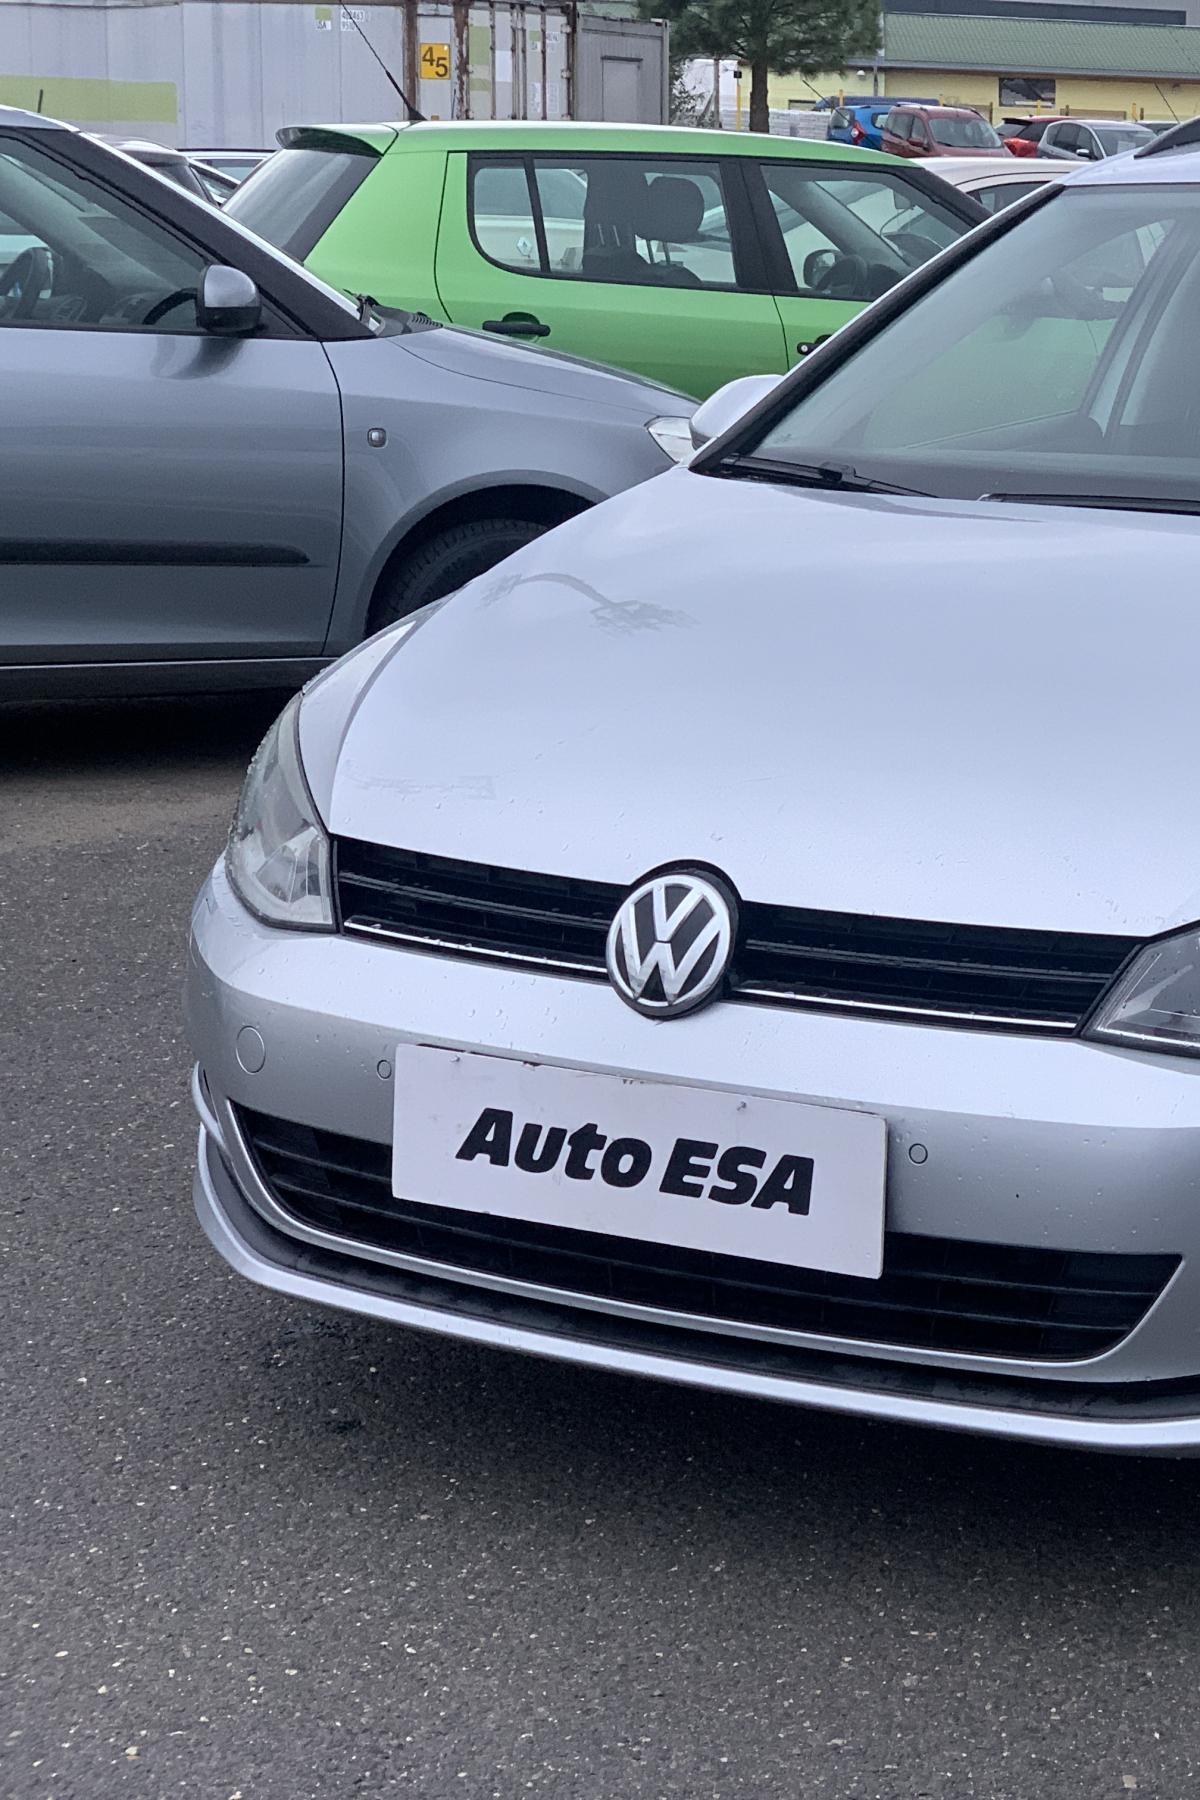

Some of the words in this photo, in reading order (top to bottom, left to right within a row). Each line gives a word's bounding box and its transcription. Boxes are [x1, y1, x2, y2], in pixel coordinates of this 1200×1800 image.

[422, 46, 448, 77] 45
[455, 1107, 652, 1188] Auto
[659, 1138, 815, 1216] ESA
